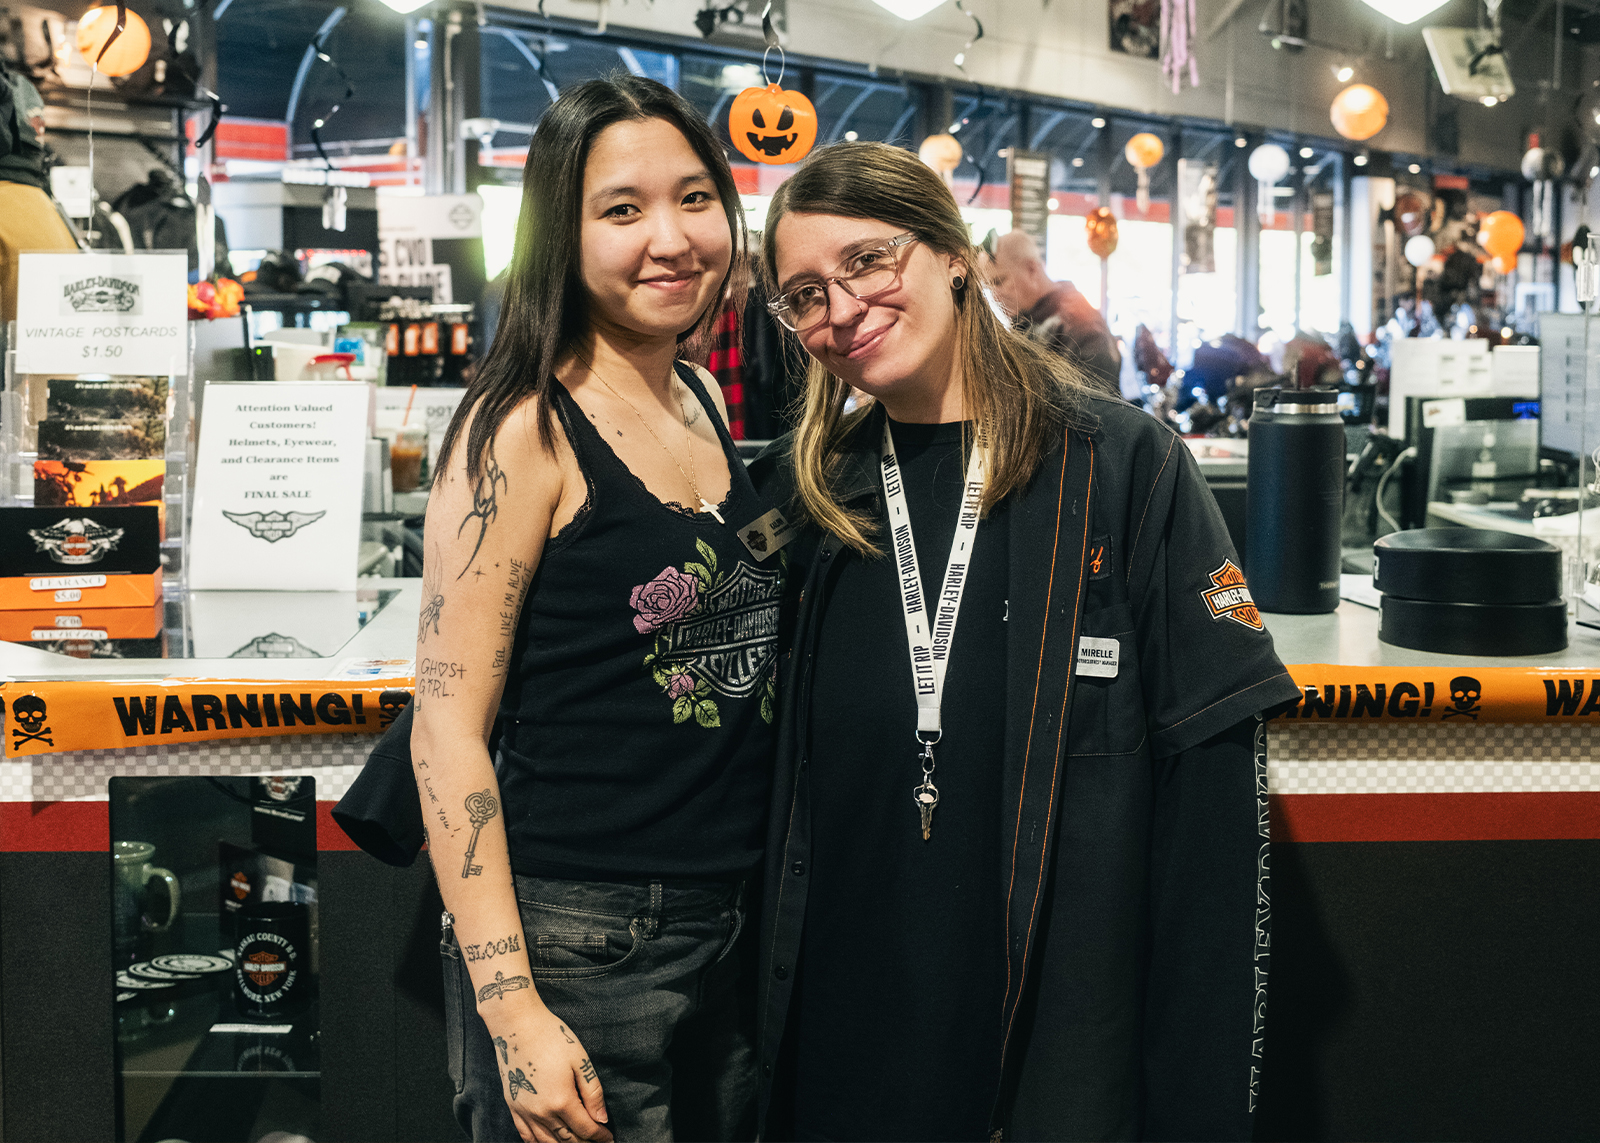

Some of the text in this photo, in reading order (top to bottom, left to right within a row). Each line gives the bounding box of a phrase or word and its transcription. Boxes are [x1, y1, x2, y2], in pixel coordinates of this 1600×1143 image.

[25, 326, 178, 338] VINTAGE POSTCARDS
[81, 345, 123, 358] $1.50
[235, 404, 333, 412] Attention Valued
[249, 421, 317, 429] Customers!
[229, 438, 337, 448] Helmets, Eyewear,
[221, 455, 340, 464] and Clearance Items
[882, 453, 901, 498] LET IT RIP
[244, 490, 312, 499] FINAL SALE
[960, 512, 978, 530] RIP
[895, 524, 923, 614] HARLEY-DAVIDSON
[31, 577, 102, 587] CLEARANCE
[493, 646, 506, 669] FEEL
[500, 611, 513, 637] LIKE
[508, 558, 522, 589] ALIVE
[932, 563, 966, 660] HARLEY-DAVIDSON
[1081, 648, 1114, 659] MIRELLE
[913, 645, 936, 695] LET IT RIP
[1280, 681, 1435, 718] NING!
[113, 693, 367, 737] WARNING!
[418, 760, 429, 769] I
[256, 932, 289, 947] COUNTY
[465, 934, 521, 964] BLOOM
[264, 989, 283, 1003] NEW
[281, 970, 297, 991] YORK
